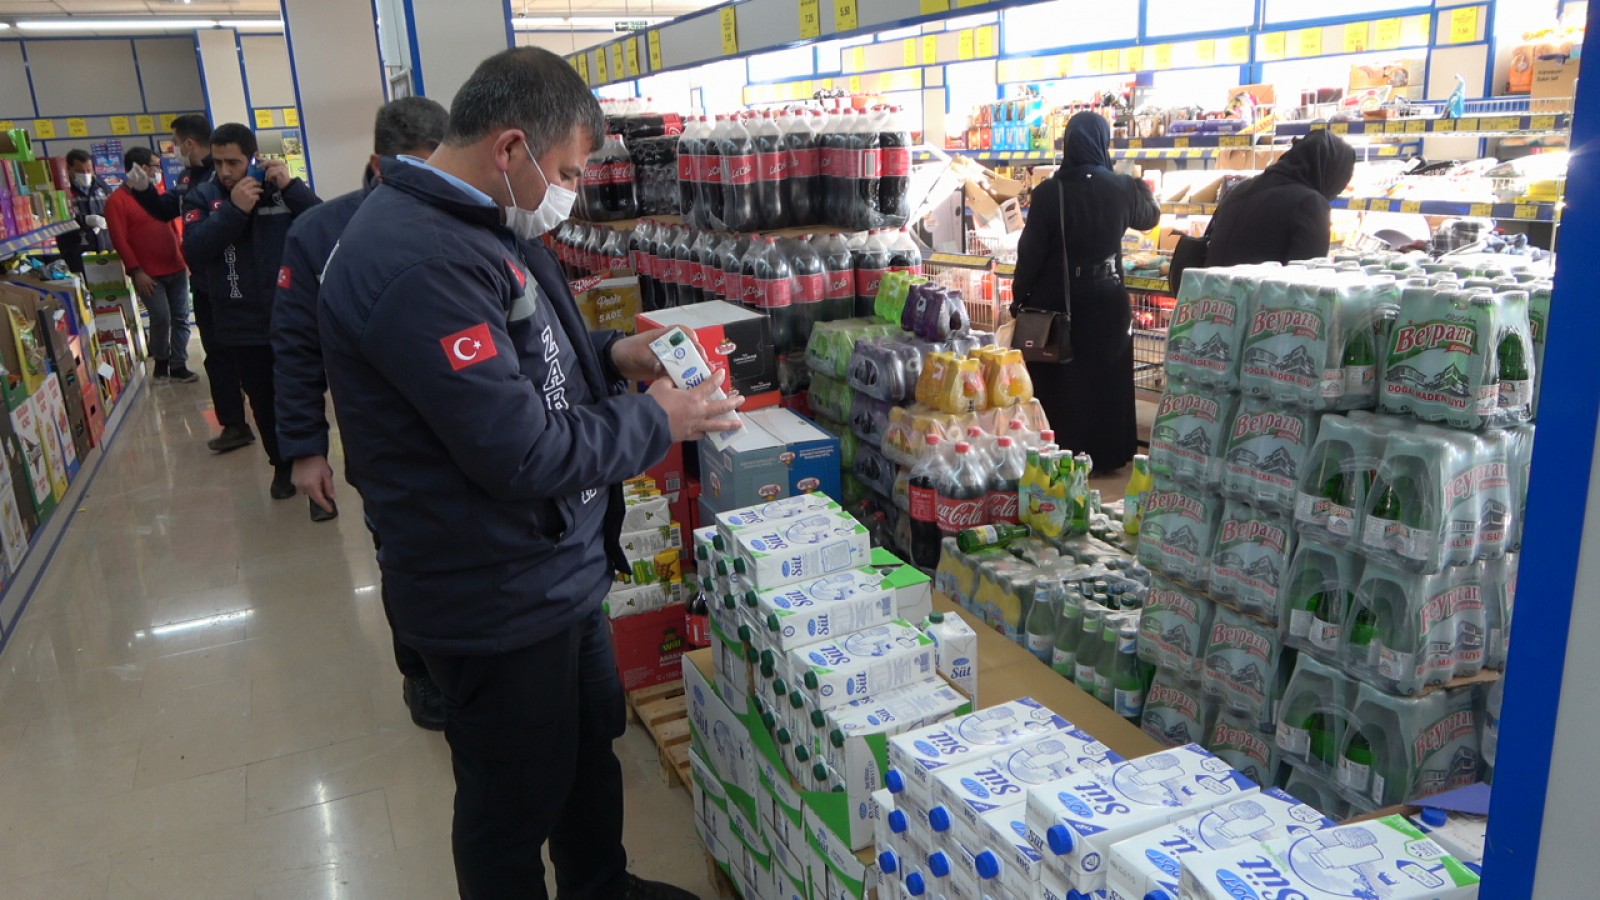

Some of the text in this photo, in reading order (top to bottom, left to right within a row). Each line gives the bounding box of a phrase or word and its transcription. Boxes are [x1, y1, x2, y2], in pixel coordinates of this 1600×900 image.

[740, 511, 764, 525] Süt
[937, 499, 985, 526] ca-Cola
[763, 533, 789, 551] Süt
[792, 555, 803, 577] Süt
[786, 589, 814, 608] Süt
[817, 613, 831, 636] Süt
[820, 644, 851, 667] Süt
[856, 670, 868, 694] Süt
[950, 665, 973, 680] Süt
[874, 707, 896, 723] Süt
[926, 730, 969, 757] Süt
[1415, 711, 1473, 768] Beypazar
[974, 765, 1022, 797] Süt
[1073, 780, 1131, 818] Süt
[1159, 834, 1203, 858] üt
[1236, 853, 1308, 900] Süt
